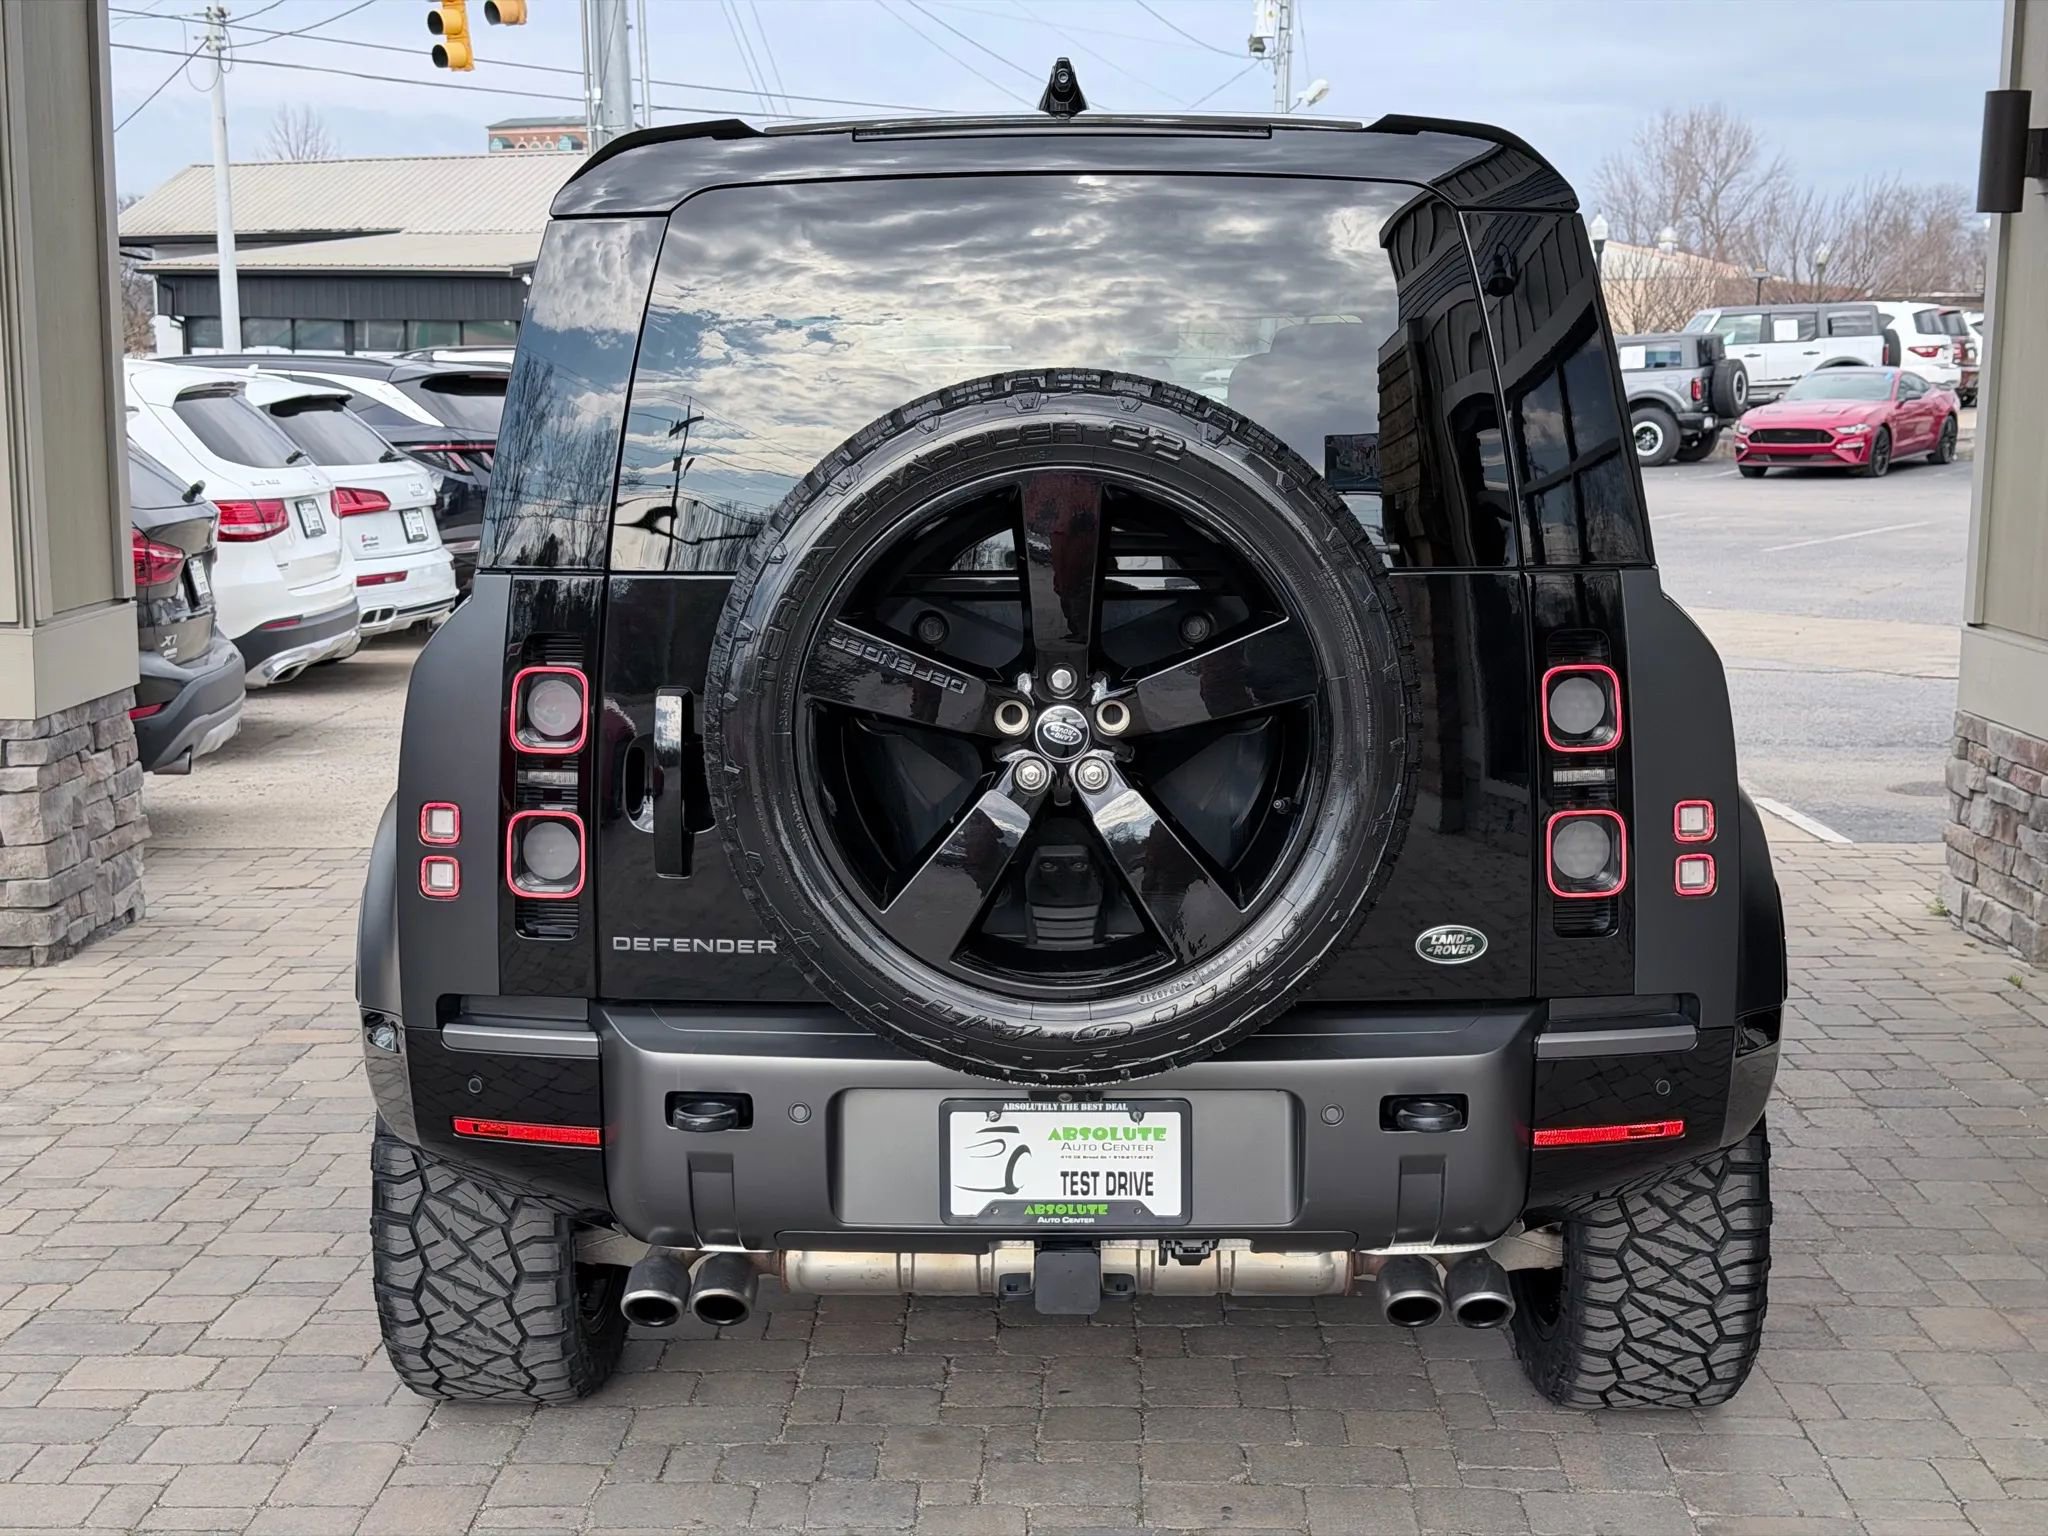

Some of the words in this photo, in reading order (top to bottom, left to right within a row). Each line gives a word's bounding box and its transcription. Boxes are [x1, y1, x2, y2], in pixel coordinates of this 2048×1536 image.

[842, 421, 1084, 530] GRAPPLER
[1107, 419, 1187, 462] G2
[828, 636, 969, 695] DEFENDER
[612, 936, 777, 954] DEFENDER
[1430, 934, 1465, 945] LAND
[1433, 944, 1475, 955] ROVER
[1002, 1102, 1059, 1111] ABSOLUTELY
[1061, 1103, 1079, 1111] THE
[1081, 1103, 1103, 1111] BEST
[1106, 1103, 1129, 1111] DEAL
[1048, 1126, 1167, 1142] ABSOLUTE
[1060, 1171, 1100, 1196] TEST
[1106, 1171, 1154, 1196] DRIVE
[1024, 1203, 1109, 1216] ABSOLUTE
[1037, 1216, 1061, 1224] AUTO
[1062, 1216, 1095, 1224] CENTER
